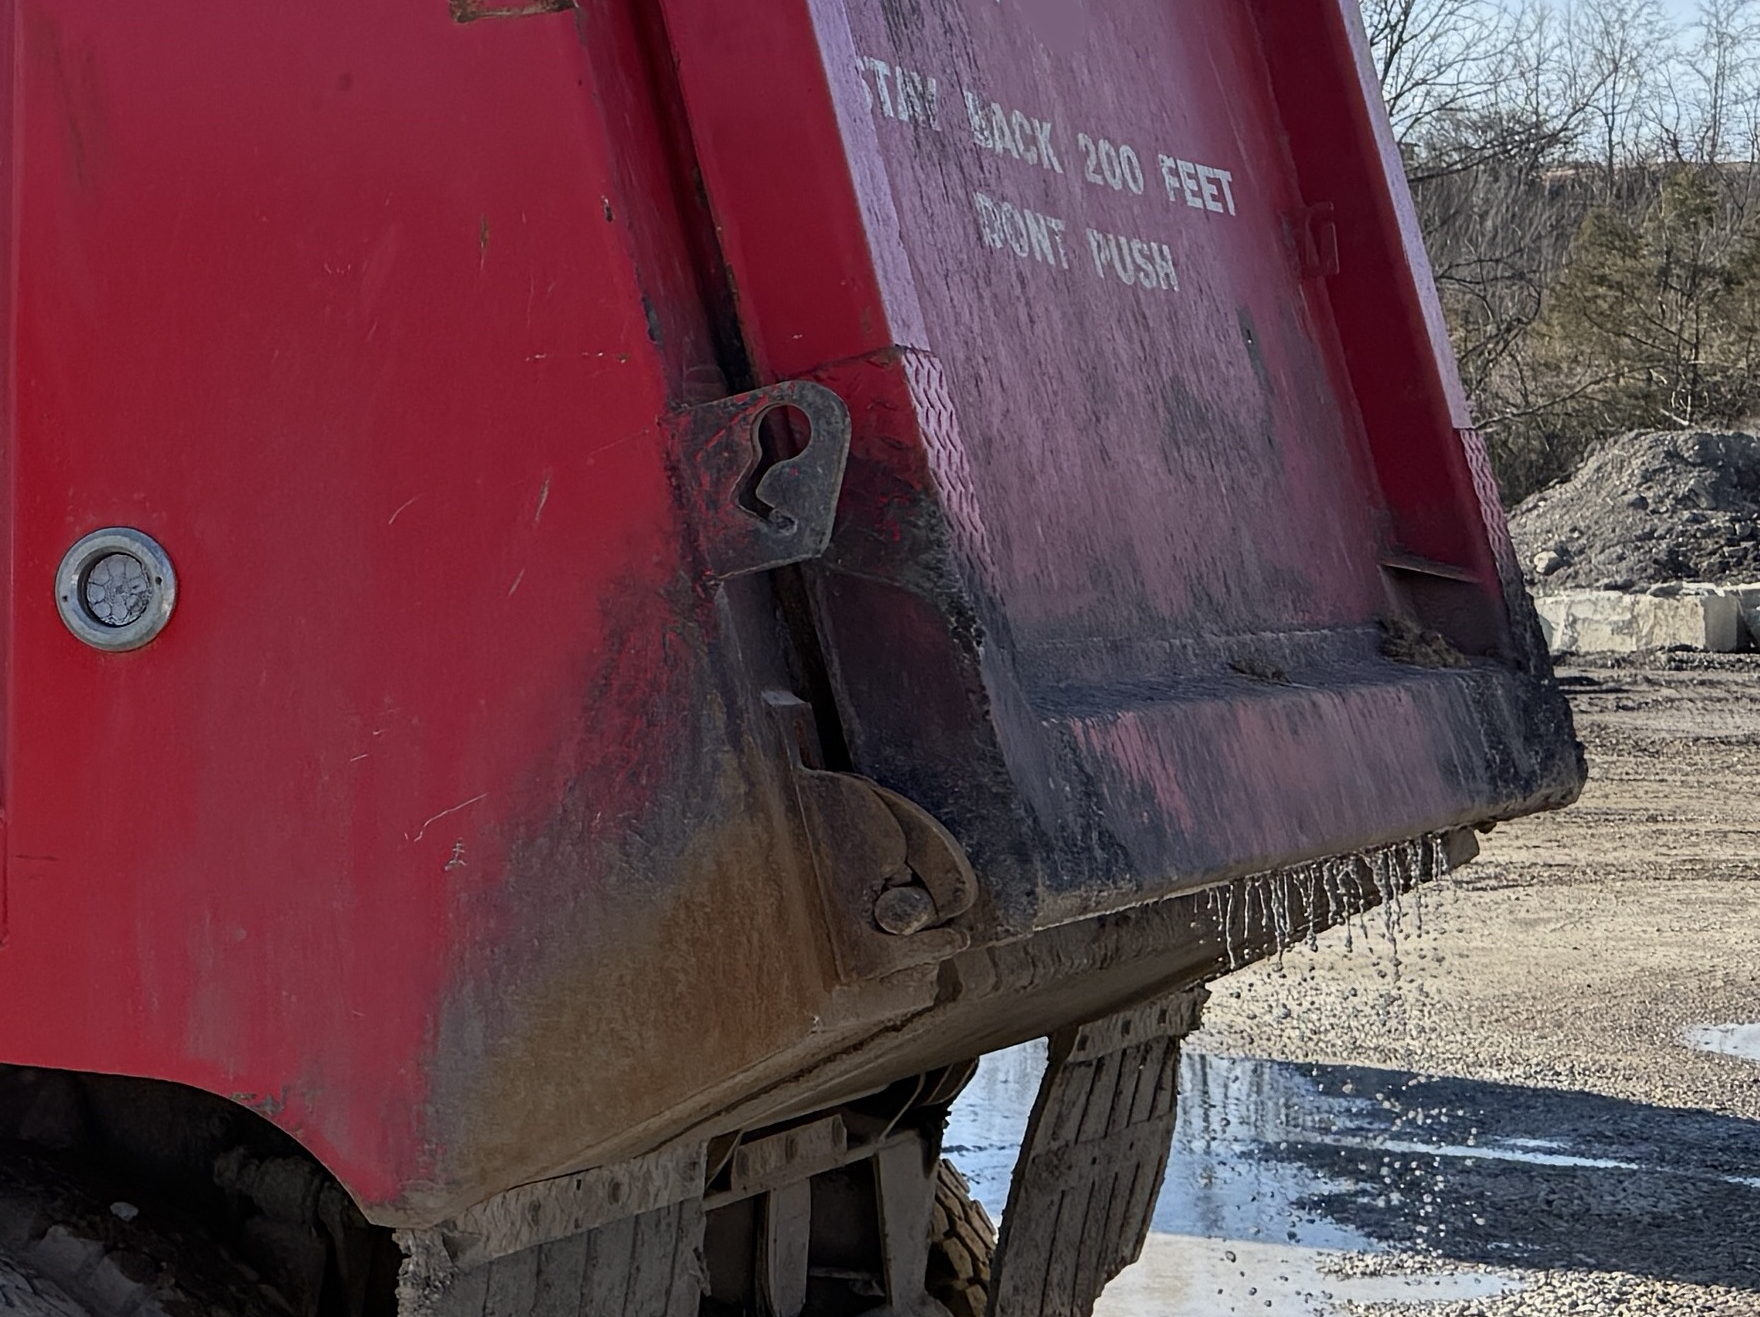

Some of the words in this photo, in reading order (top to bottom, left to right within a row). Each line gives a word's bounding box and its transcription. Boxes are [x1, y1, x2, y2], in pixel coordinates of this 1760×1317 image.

[963, 88, 1065, 174] BACK
[1076, 132, 1145, 196] 200
[1157, 153, 1237, 217] FEET
[973, 191, 1070, 270] DONT
[1085, 226, 1180, 293] PUSH
